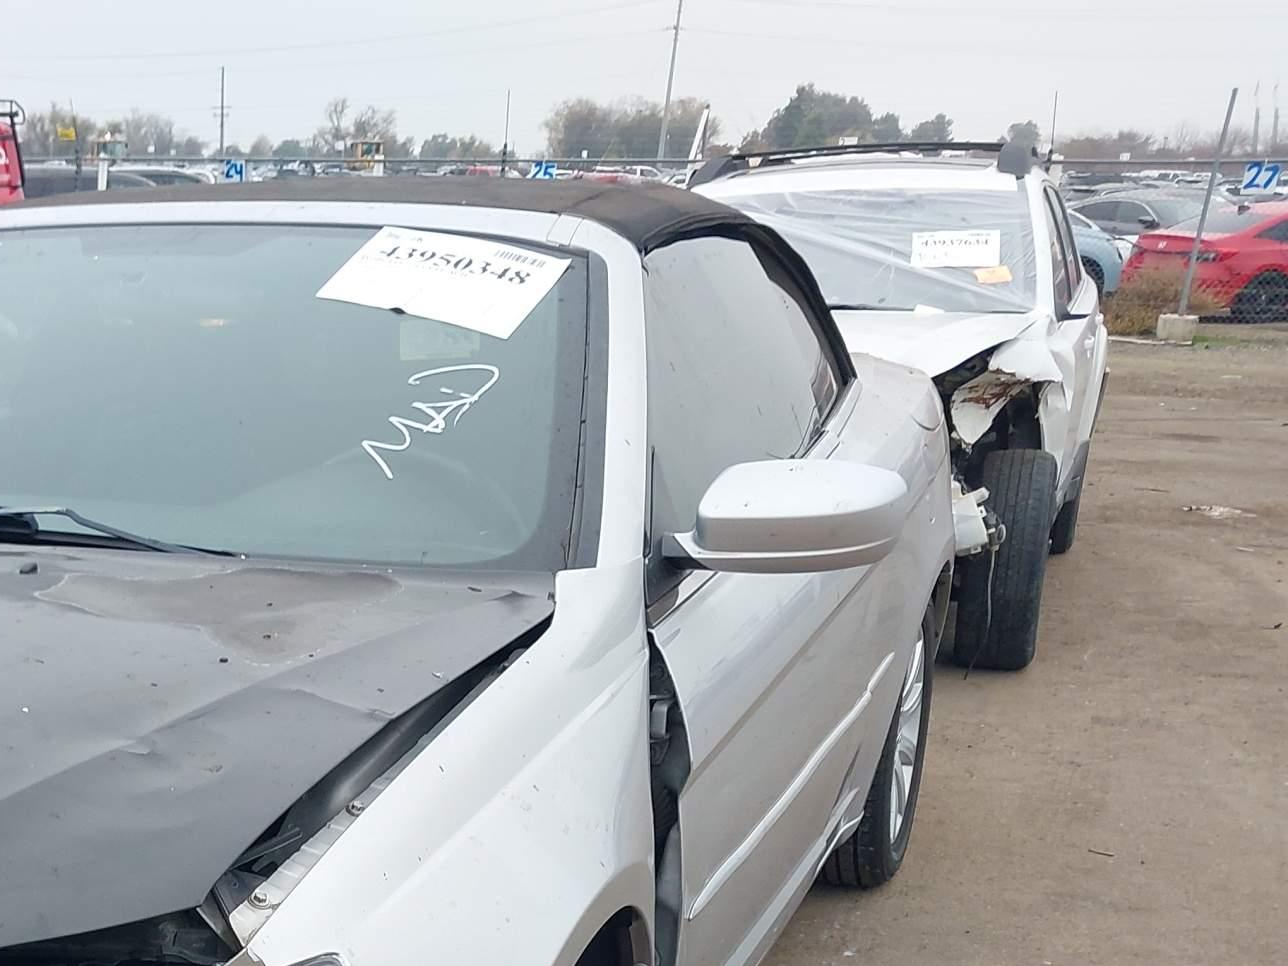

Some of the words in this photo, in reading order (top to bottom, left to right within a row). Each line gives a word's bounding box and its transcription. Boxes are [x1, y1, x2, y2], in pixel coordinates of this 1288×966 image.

[225, 160, 243, 182] 24
[532, 161, 555, 179] 25
[1243, 161, 1280, 190] 27
[379, 244, 532, 285] 43950348
